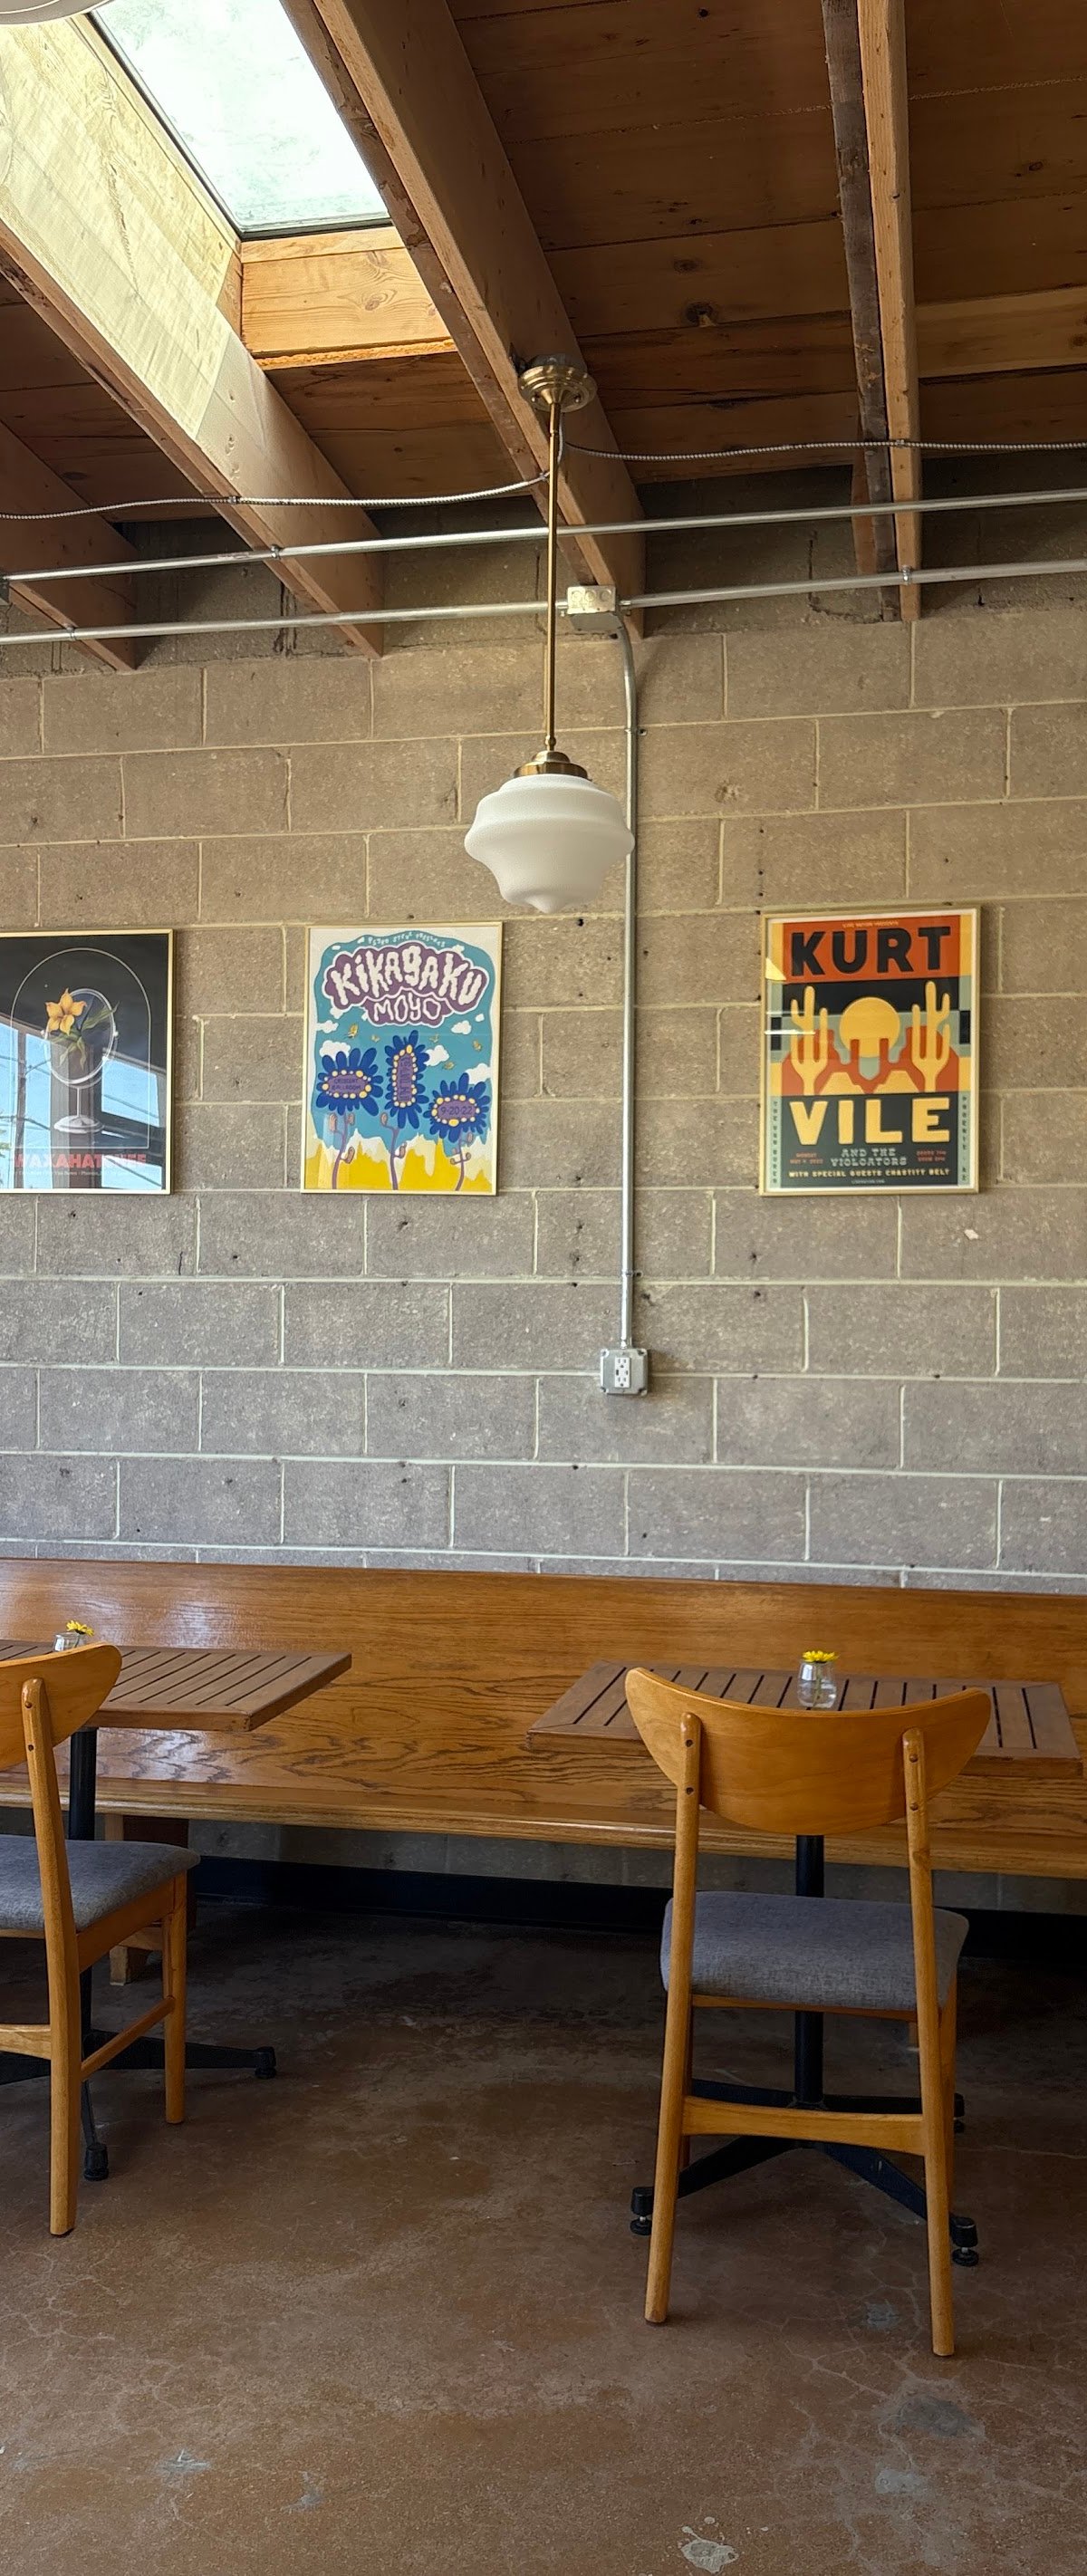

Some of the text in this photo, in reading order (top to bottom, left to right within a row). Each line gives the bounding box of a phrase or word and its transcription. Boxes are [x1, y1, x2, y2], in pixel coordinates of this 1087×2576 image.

[791, 926, 951, 976] KURT
[789, 1097, 950, 1146] VILE
[841, 1147, 896, 1158] AND THE
[12, 1153, 146, 1168] WAXAHATE
[812, 1169, 847, 1177] SPECIAL
[850, 1168, 882, 1177] GUESTS
[885, 1168, 926, 1177] CHASTITY
[928, 1167, 950, 1176] BELT
